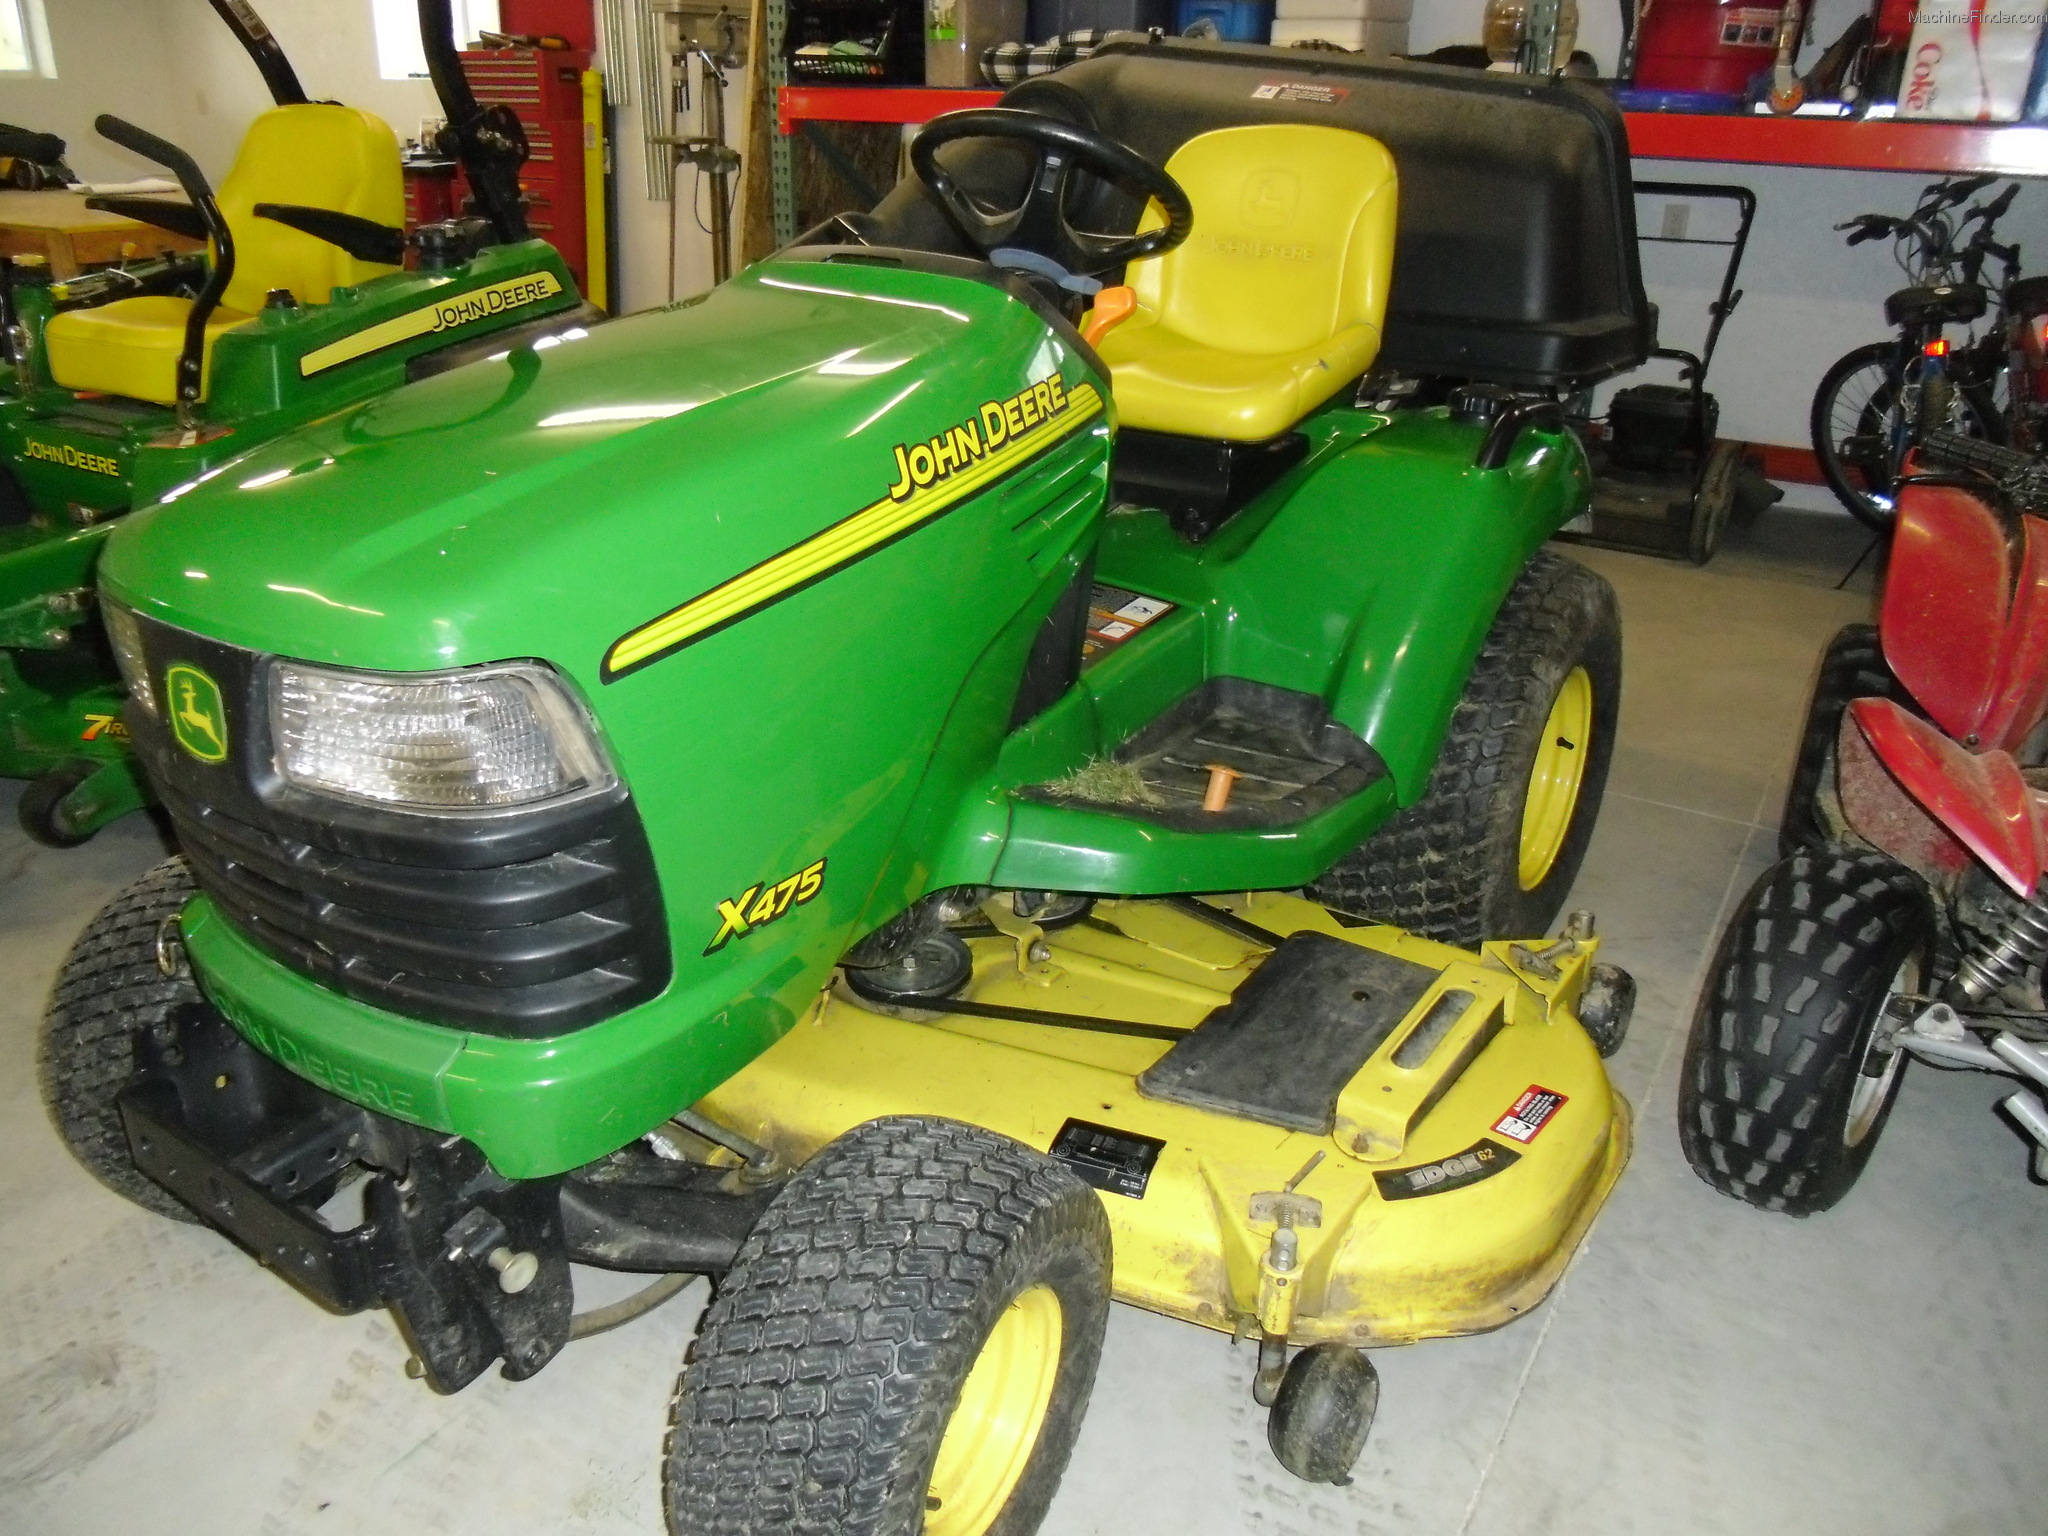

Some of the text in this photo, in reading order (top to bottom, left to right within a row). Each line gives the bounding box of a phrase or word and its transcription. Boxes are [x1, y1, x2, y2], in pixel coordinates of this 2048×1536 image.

[1906, 43, 1942, 112] Coke
[432, 279, 550, 332] JOHN DEERE
[23, 437, 120, 477] JOHN DEERE
[888, 371, 1068, 502] JOHN DEERE
[702, 857, 828, 957] X475
